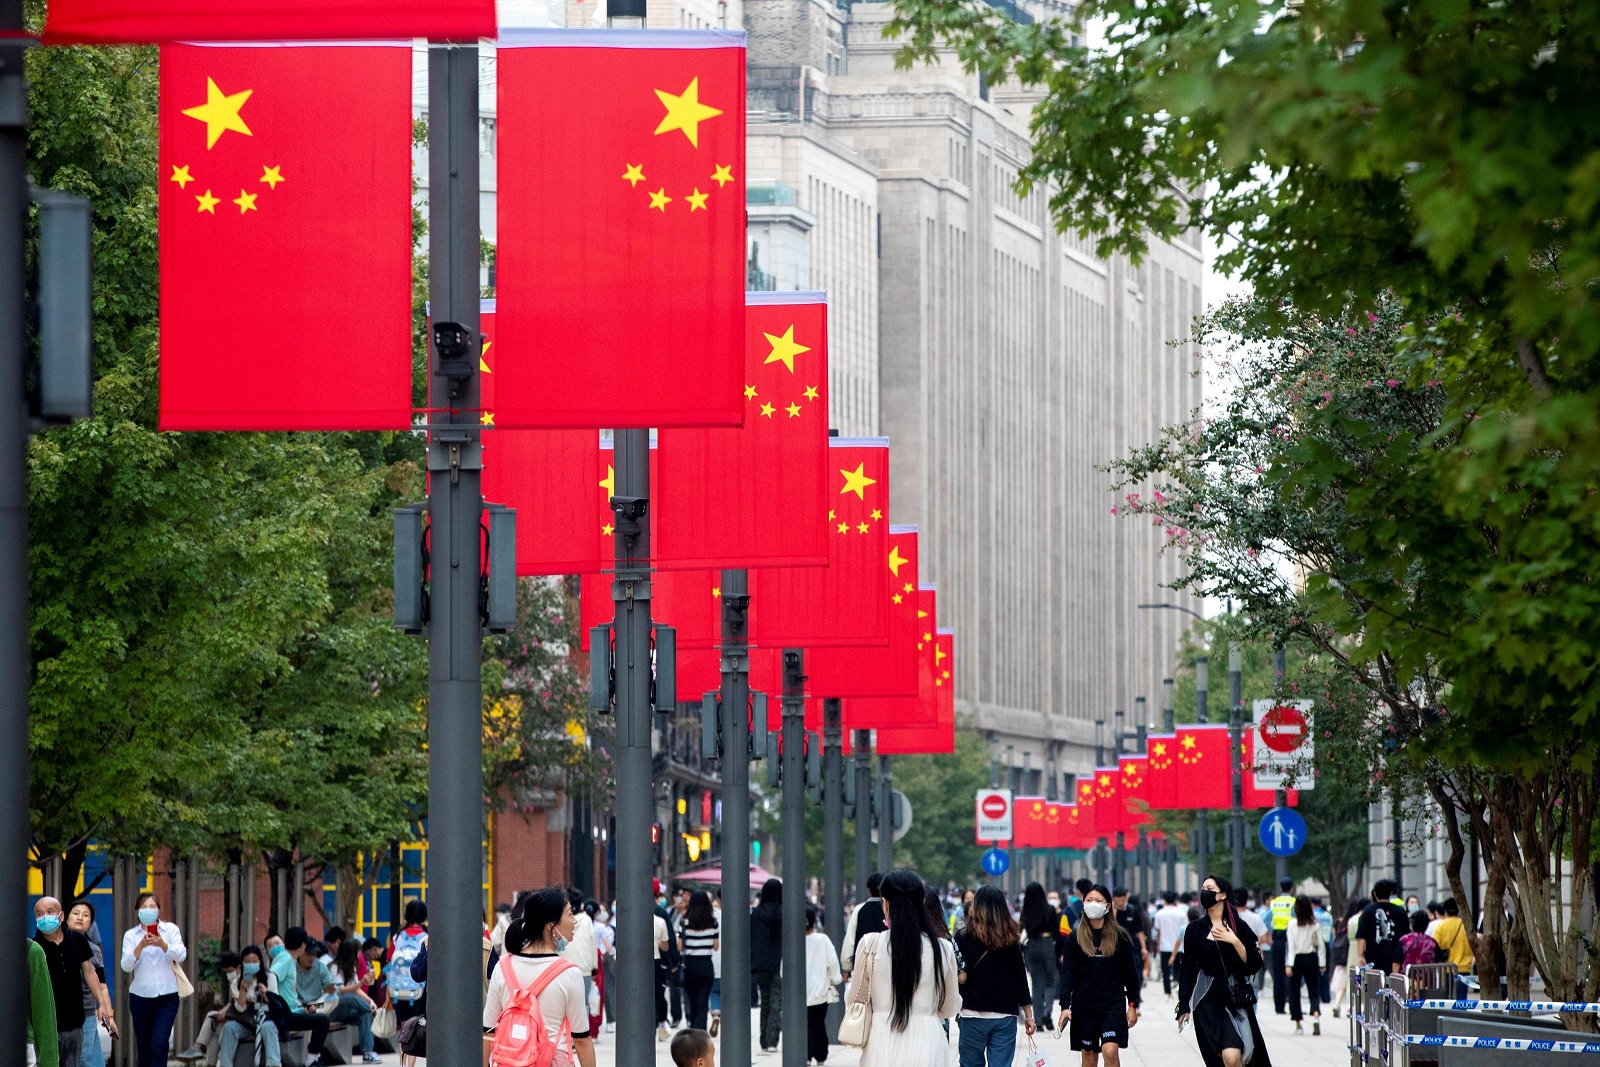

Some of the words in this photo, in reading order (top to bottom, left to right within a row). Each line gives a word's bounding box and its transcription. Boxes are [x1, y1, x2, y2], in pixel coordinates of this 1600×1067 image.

[1455, 1001, 1474, 1009] POLICE
[1509, 1002, 1528, 1010] POLICE
[1563, 1003, 1583, 1011] POLICE
[1477, 1039, 1496, 1047] POLICE
[1531, 1041, 1550, 1050] POLICE
